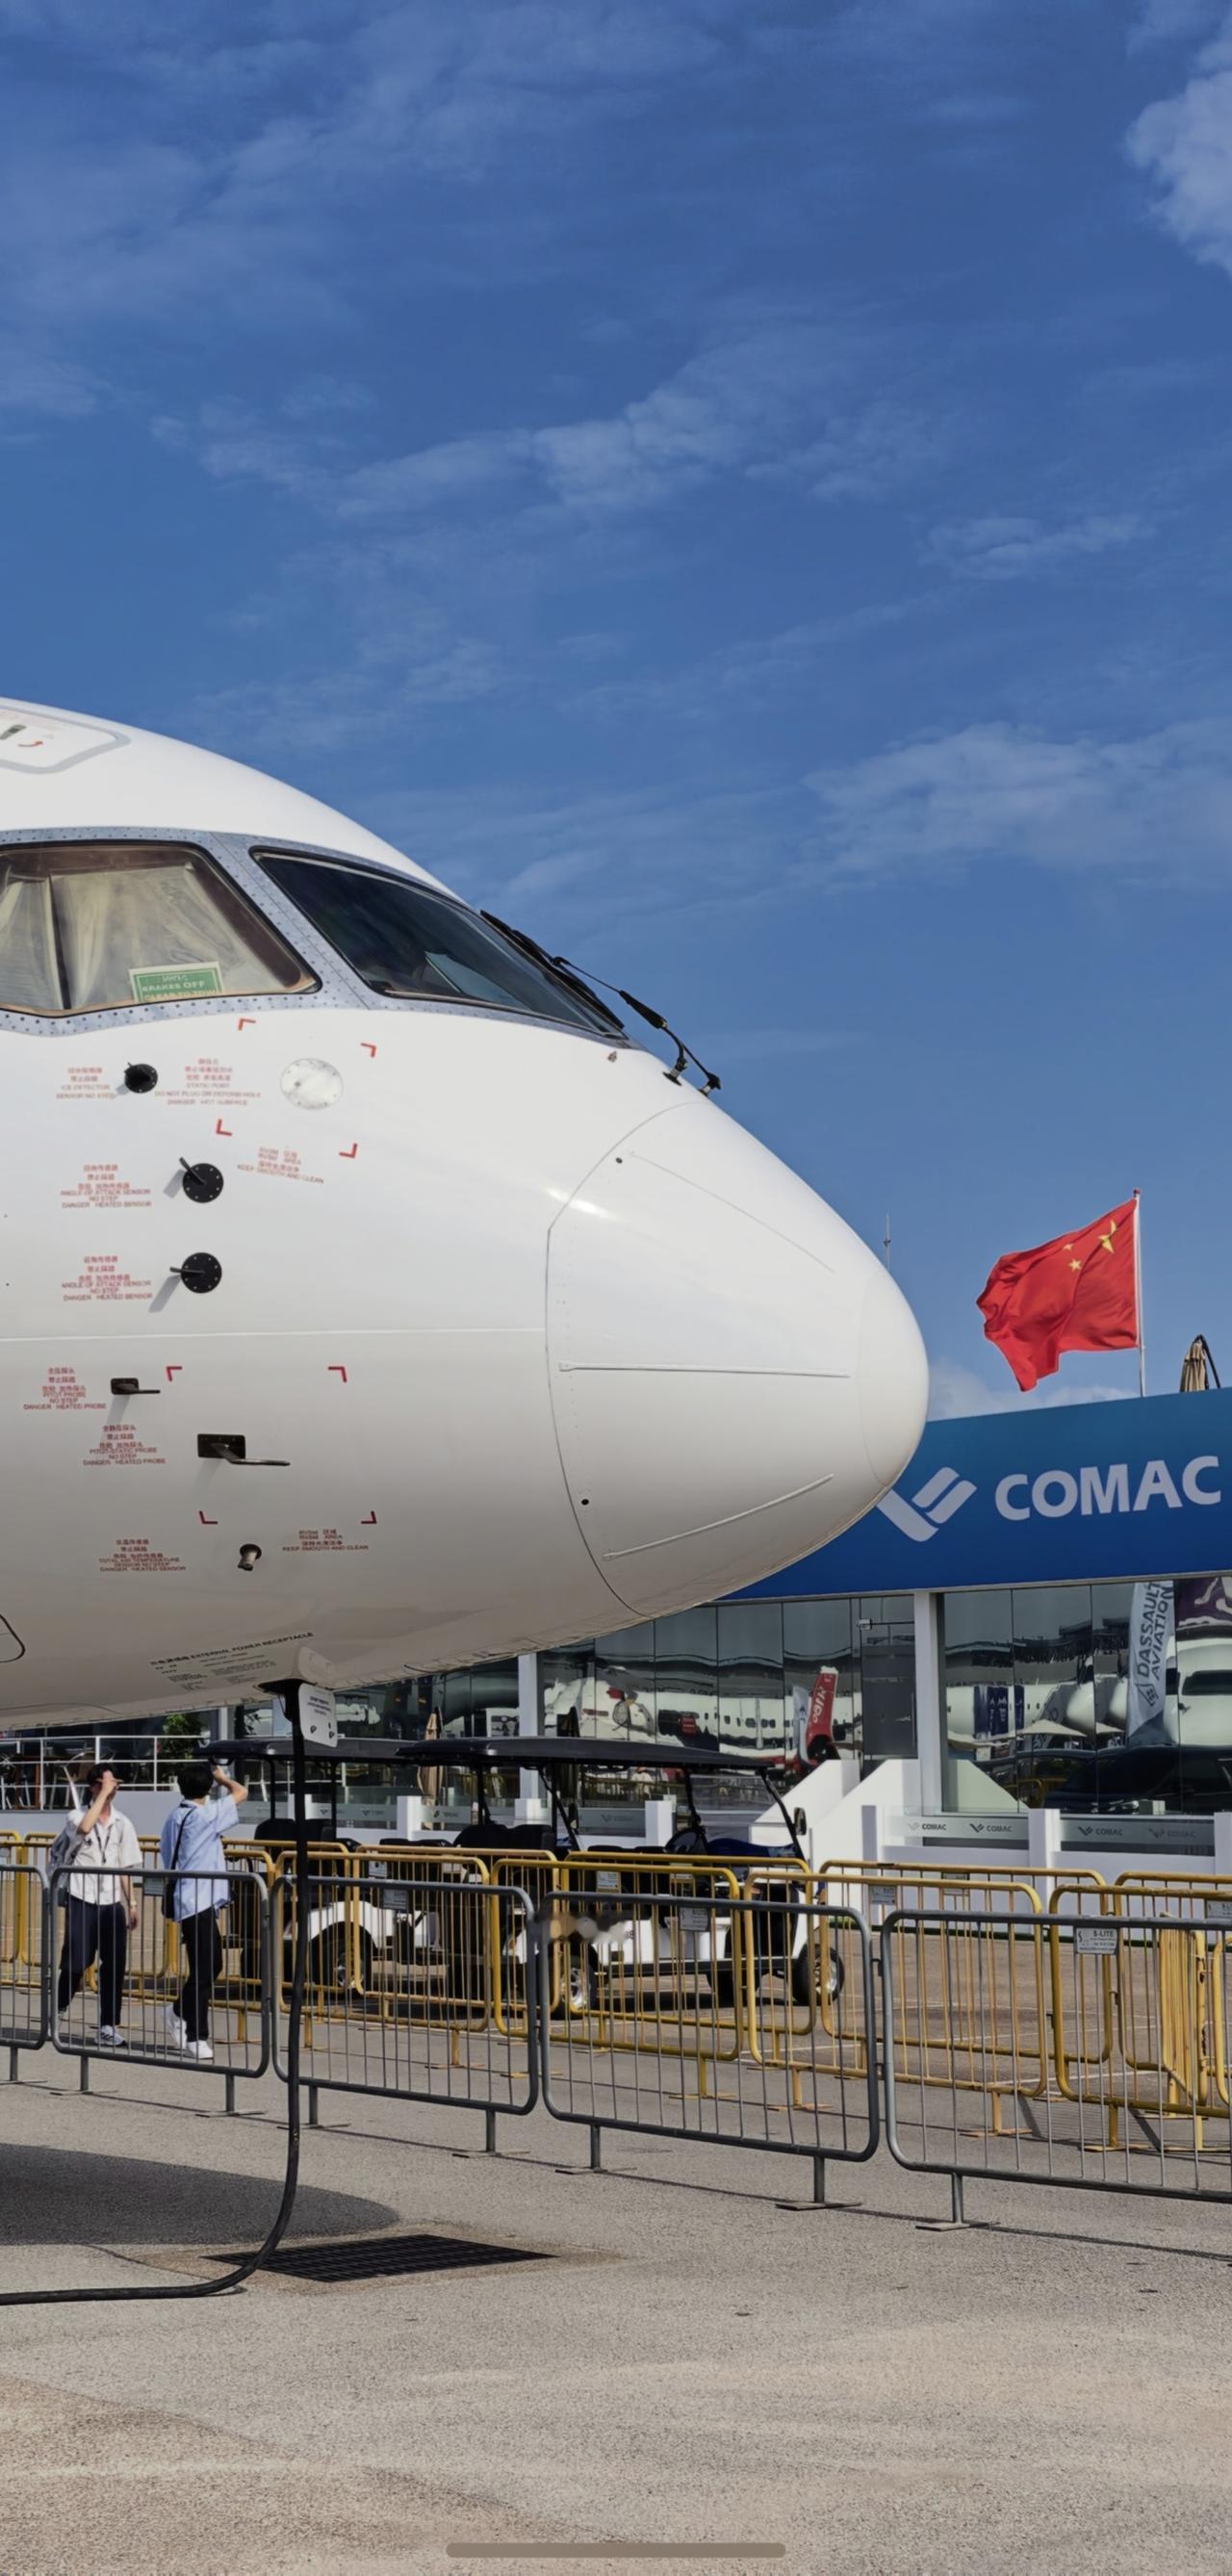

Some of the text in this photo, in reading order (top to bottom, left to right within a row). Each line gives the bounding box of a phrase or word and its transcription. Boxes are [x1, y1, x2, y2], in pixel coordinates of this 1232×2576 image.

[142, 980, 205, 992] BRAKES OFF
[994, 1455, 1221, 1521] COMAC
[1137, 1582, 1161, 1678] DASSAULT
[1151, 1585, 1174, 1681] AVIATION
[232, 1642, 262, 1652] POWER
[262, 1632, 315, 1645] RECEPTACLE
[922, 1822, 947, 1831] COMAC
[987, 1824, 1014, 1833] COMAC
[1095, 1827, 1124, 1836] COMAC
